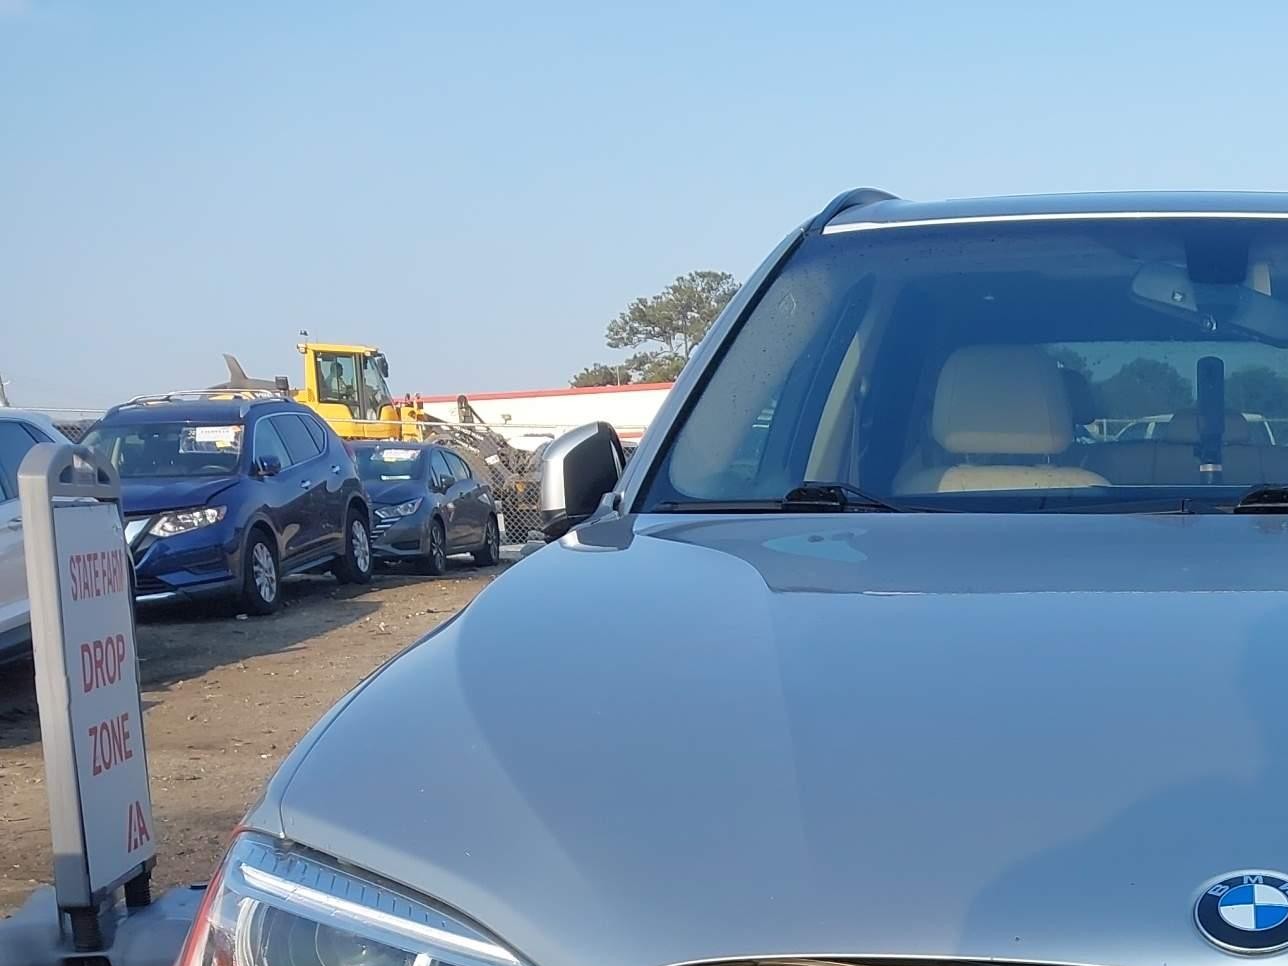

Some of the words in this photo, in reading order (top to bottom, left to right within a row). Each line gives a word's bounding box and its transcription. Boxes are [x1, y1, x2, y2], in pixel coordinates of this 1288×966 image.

[69, 553, 100, 601] STATE
[100, 549, 124, 595] FARM
[80, 634, 126, 693] DROP
[88, 713, 133, 776] ZONE
